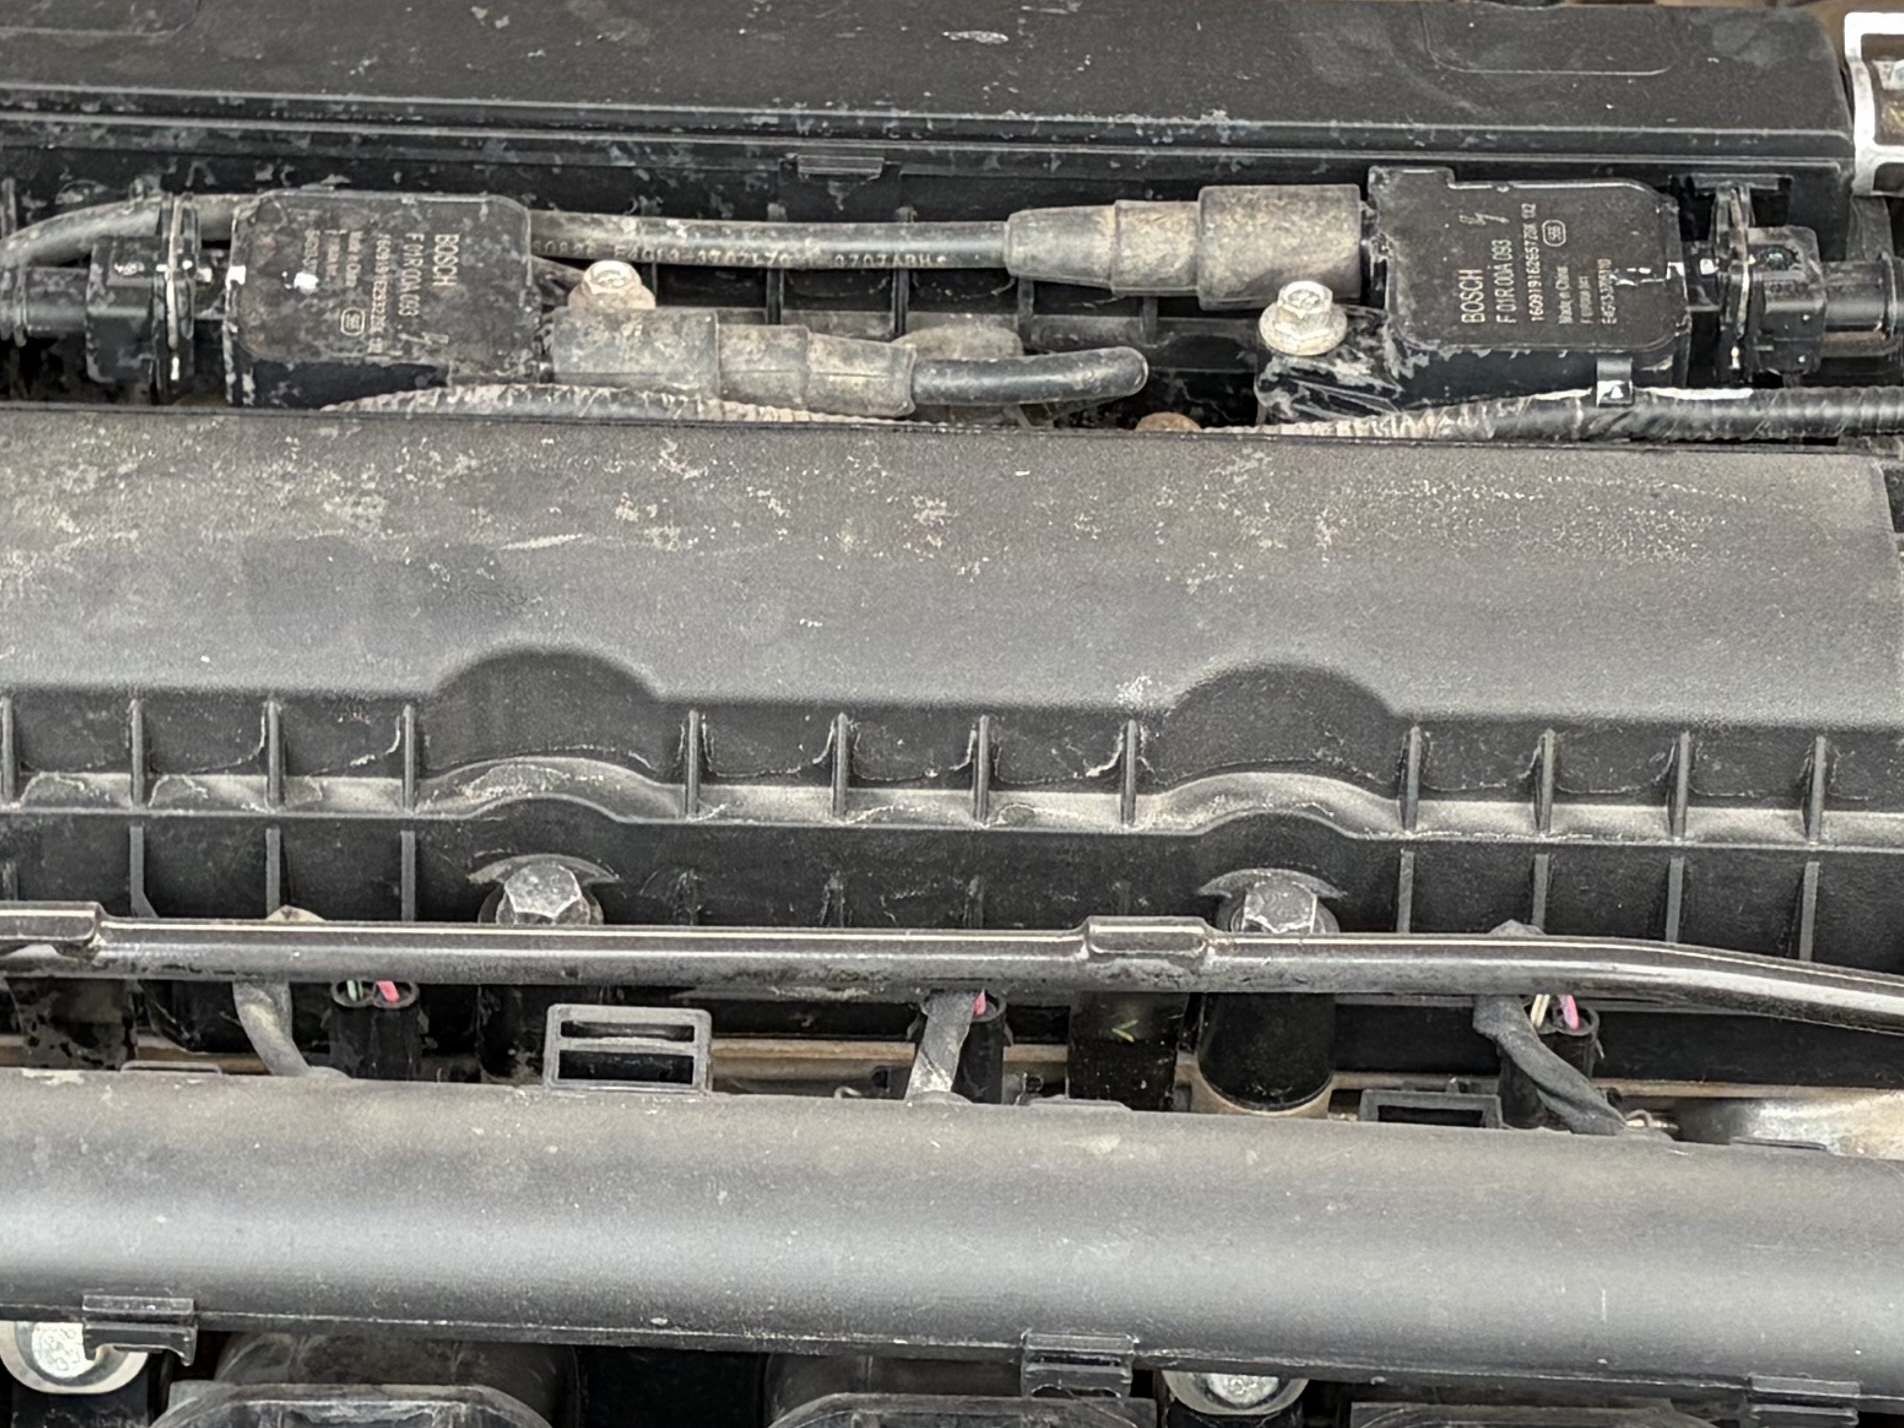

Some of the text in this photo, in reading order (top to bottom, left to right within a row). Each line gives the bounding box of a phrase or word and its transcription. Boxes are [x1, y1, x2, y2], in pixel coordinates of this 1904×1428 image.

[406, 232, 425, 242] F
[432, 234, 459, 287] BOSCH
[1458, 269, 1485, 322] BOSCH
[1496, 315, 1517, 323] F
